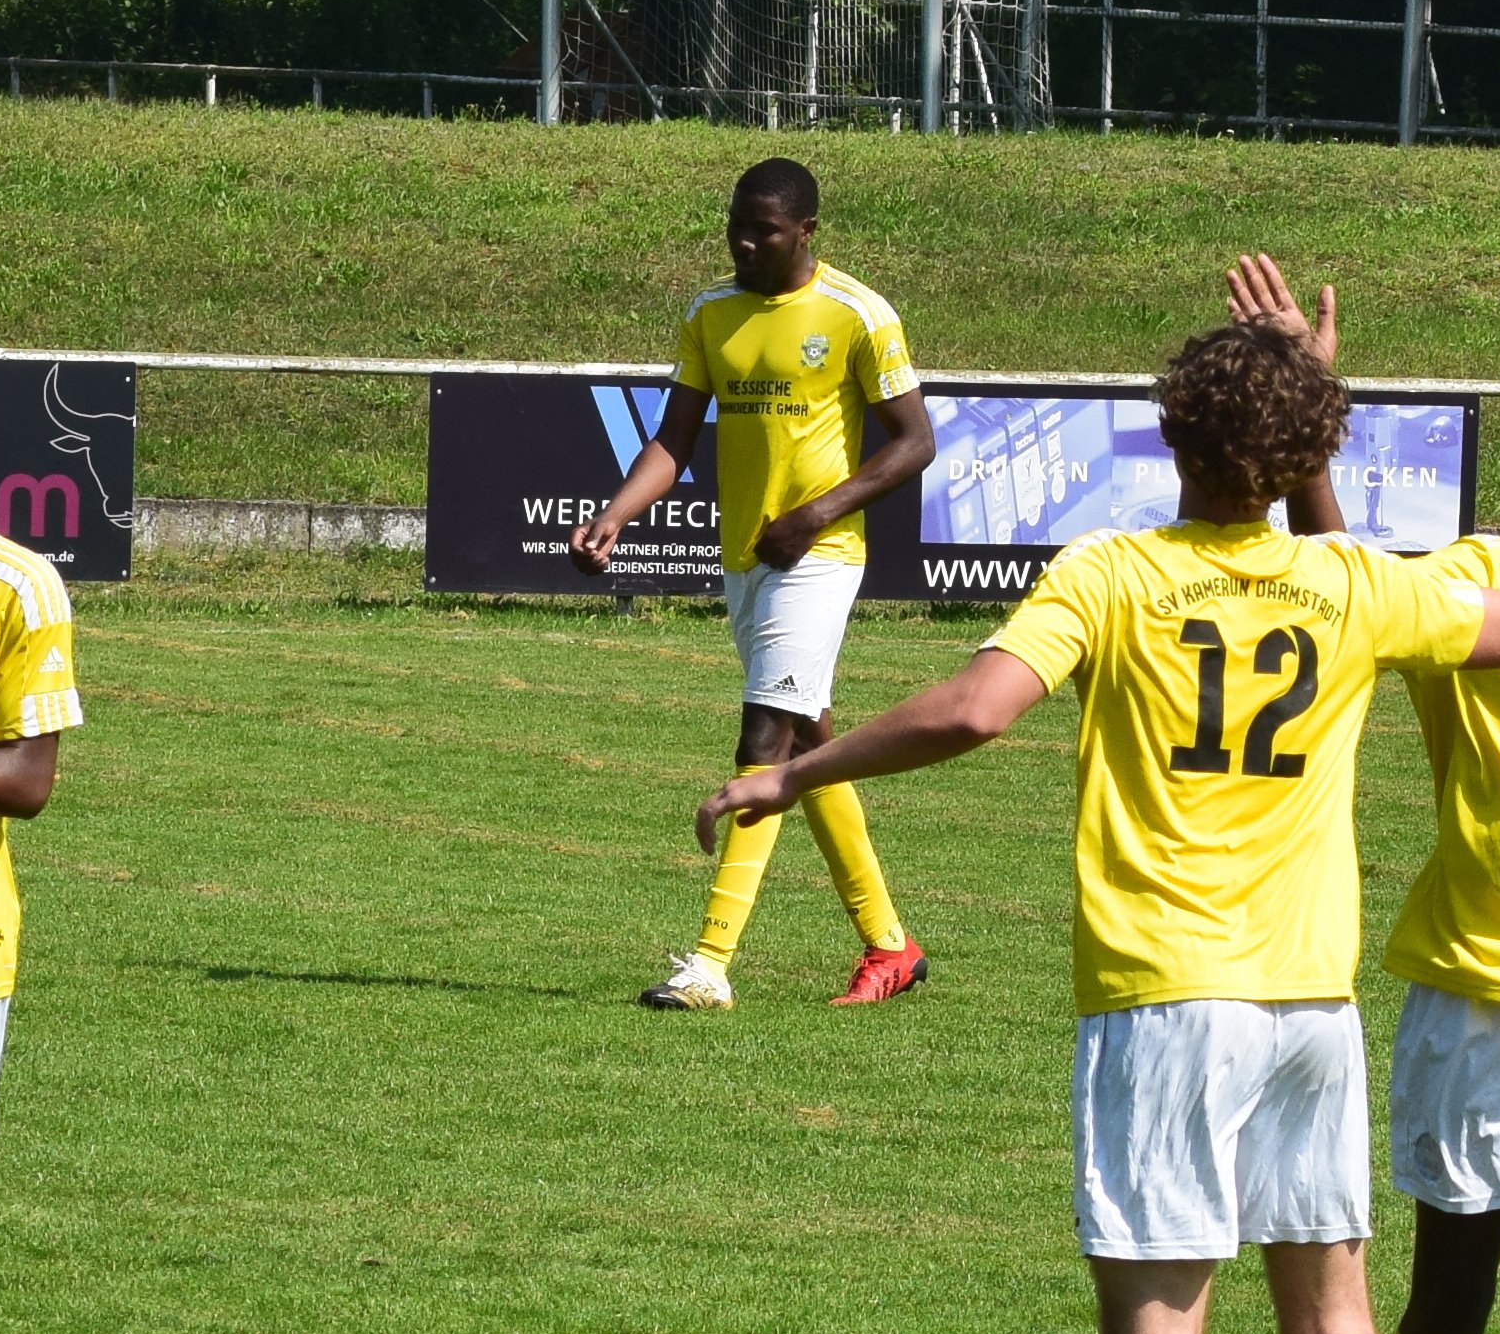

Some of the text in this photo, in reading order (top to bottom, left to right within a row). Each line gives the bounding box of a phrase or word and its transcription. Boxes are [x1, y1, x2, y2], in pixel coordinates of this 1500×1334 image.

[726, 379, 792, 397] HESSISCHE
[776, 401, 810, 417] GMBH
[1332, 465, 1437, 488] TICKEN
[522, 498, 722, 528] WERTECH
[43, 550, 75, 563] m.de
[522, 541, 723, 558] WIR SIN ARTNER FÜR PROF
[1157, 577, 1342, 627] SV KAMERUN DARMSTADT
[1169, 618, 1319, 778] 12
